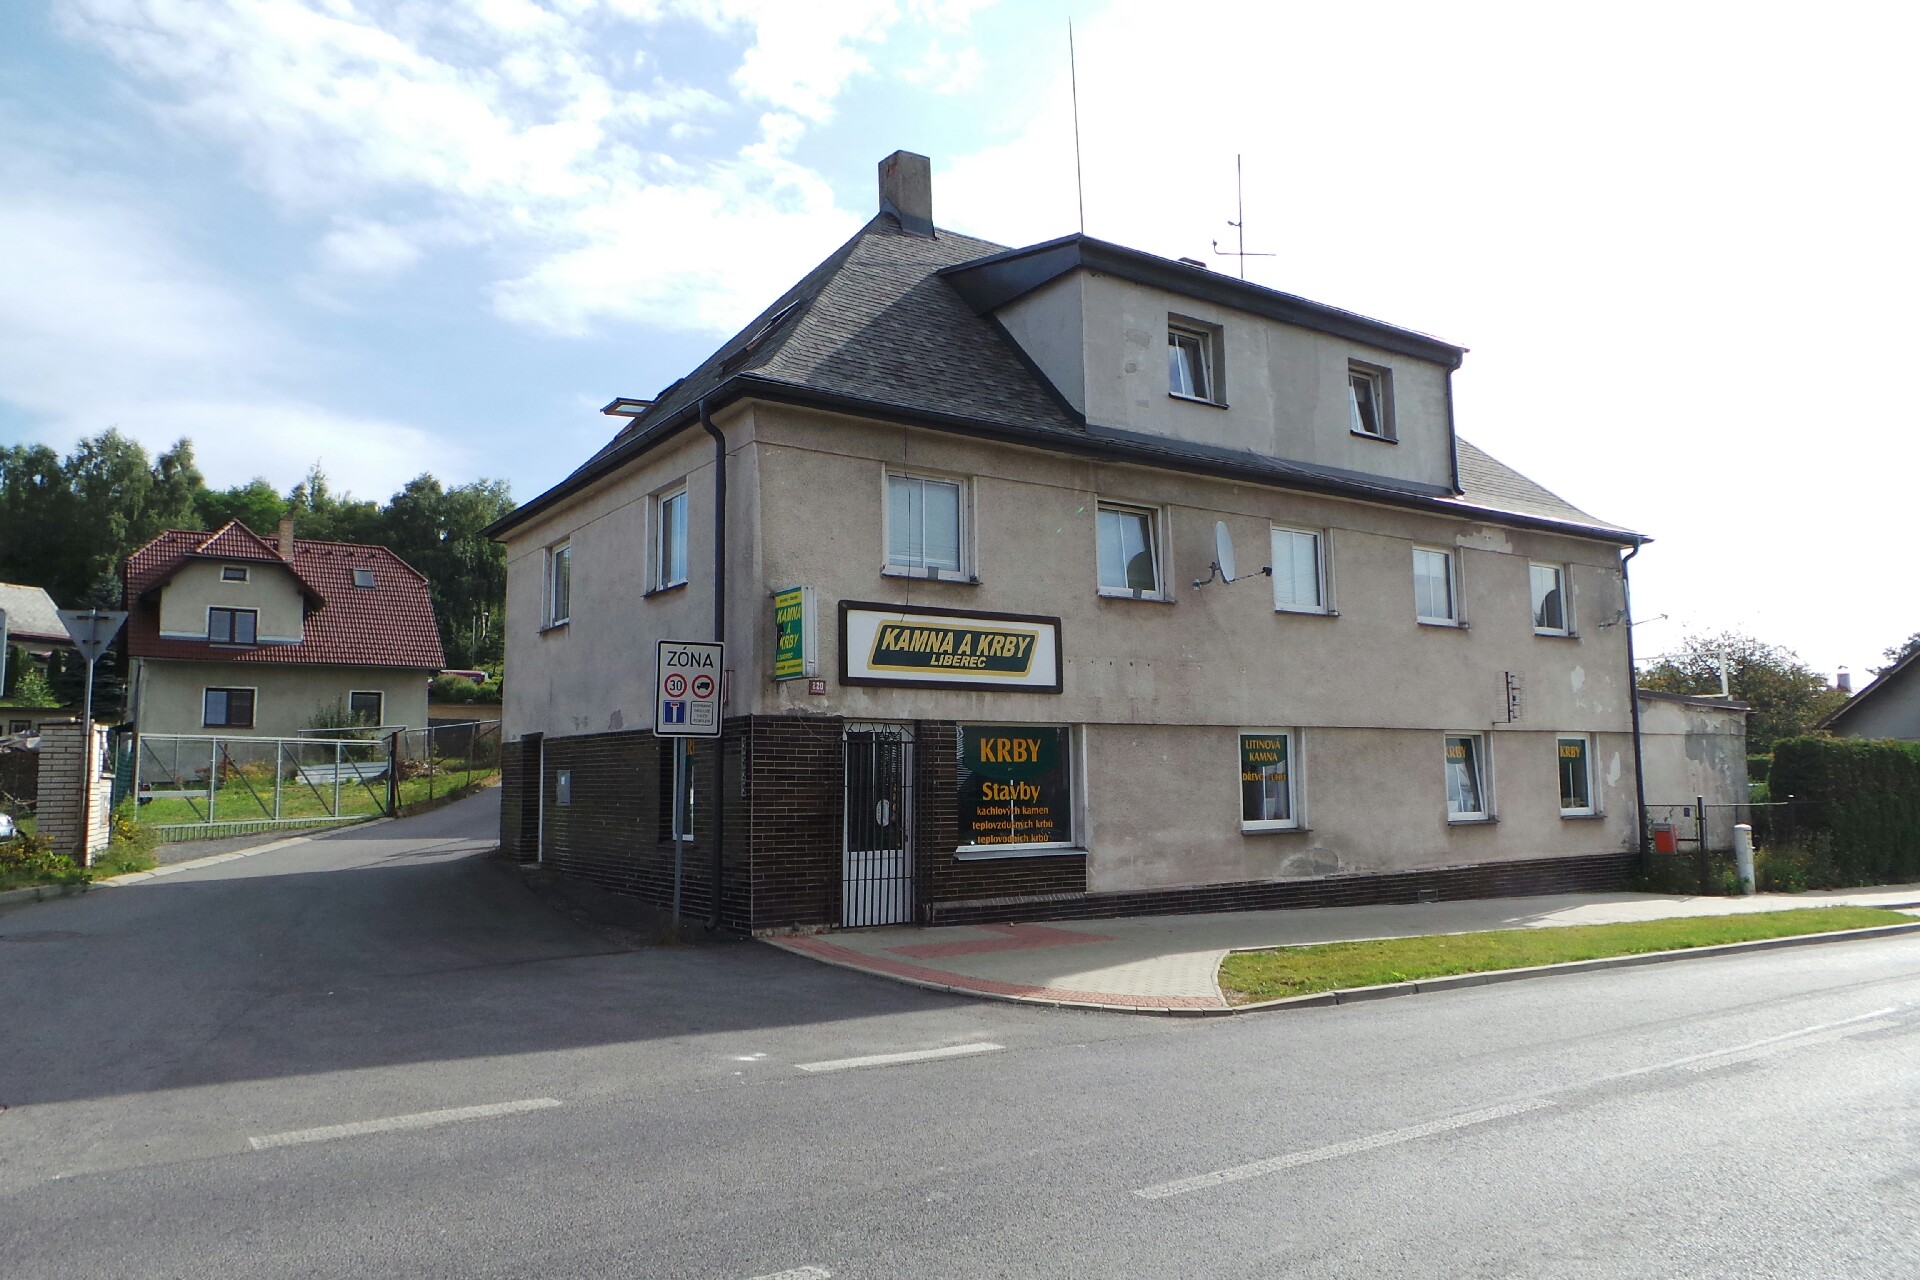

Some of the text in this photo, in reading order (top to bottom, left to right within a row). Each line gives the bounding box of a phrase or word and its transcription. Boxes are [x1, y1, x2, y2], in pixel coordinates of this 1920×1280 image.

[777, 605, 801, 624] KAMNA
[786, 622, 792, 634] A
[779, 633, 800, 650] KRBY
[881, 627, 1031, 658] KAMNA A KRBY
[667, 646, 714, 668] ZÓNA
[930, 654, 987, 668] LIBEREC
[669, 680, 683, 691] 30
[980, 737, 1042, 763] KRBY
[1245, 738, 1281, 750] LITINOVÁ
[1249, 752, 1278, 762] KAMNA
[1446, 745, 1467, 758] KRBY
[1559, 745, 1581, 758] KRBY
[982, 781, 1041, 804] Stavby
[977, 806, 1049, 816] kachlových kamen
[1035, 820, 1054, 828] krbů
[1030, 833, 1049, 842] krbů
